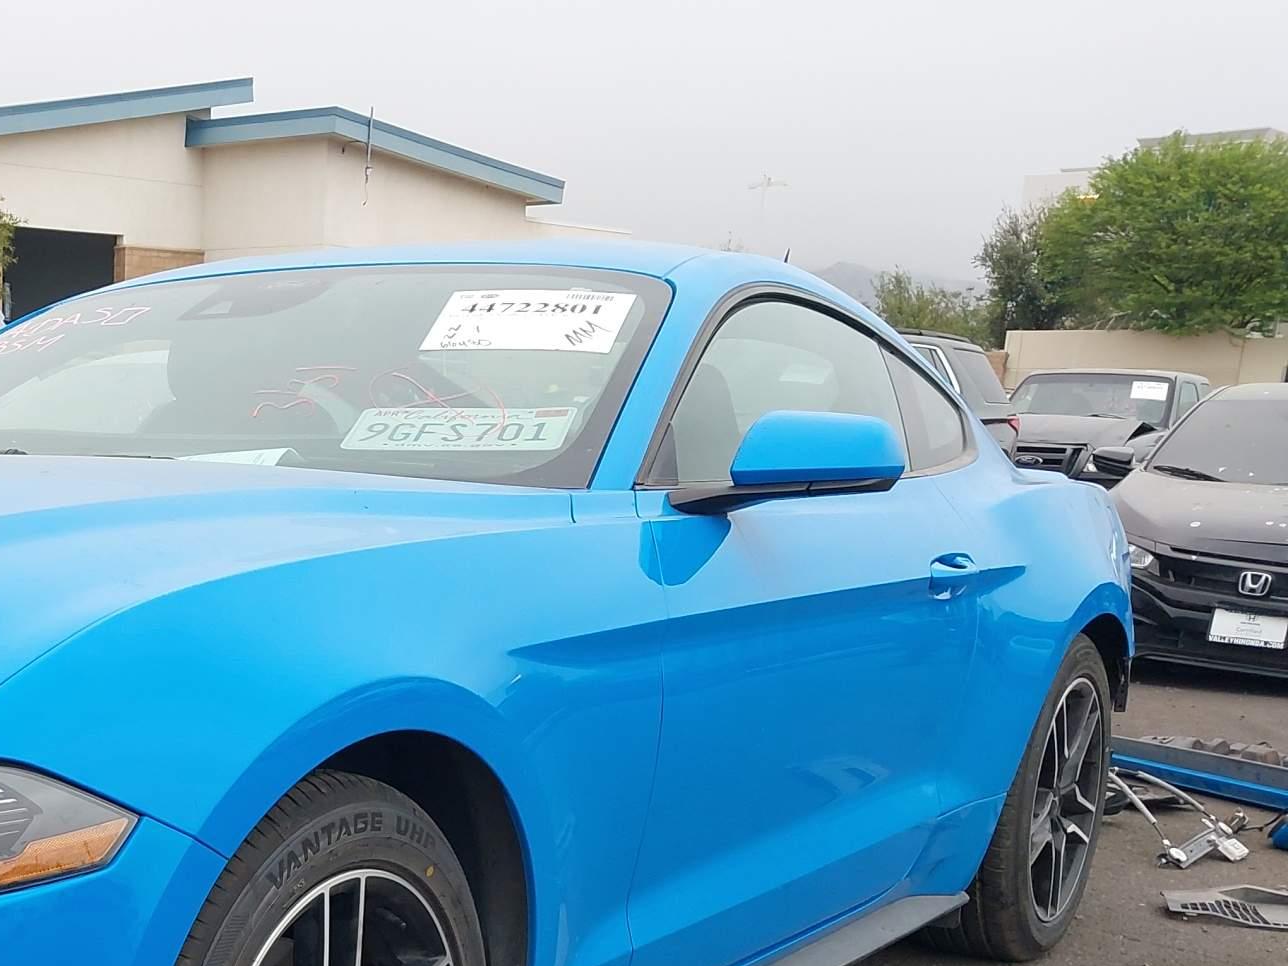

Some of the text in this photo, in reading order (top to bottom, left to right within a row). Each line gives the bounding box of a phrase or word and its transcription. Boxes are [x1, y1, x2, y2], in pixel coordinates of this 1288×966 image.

[460, 302, 603, 315] 44722801
[403, 409, 522, 423] California
[358, 422, 548, 442] 9GFS701
[267, 811, 383, 889] VANTAGE
